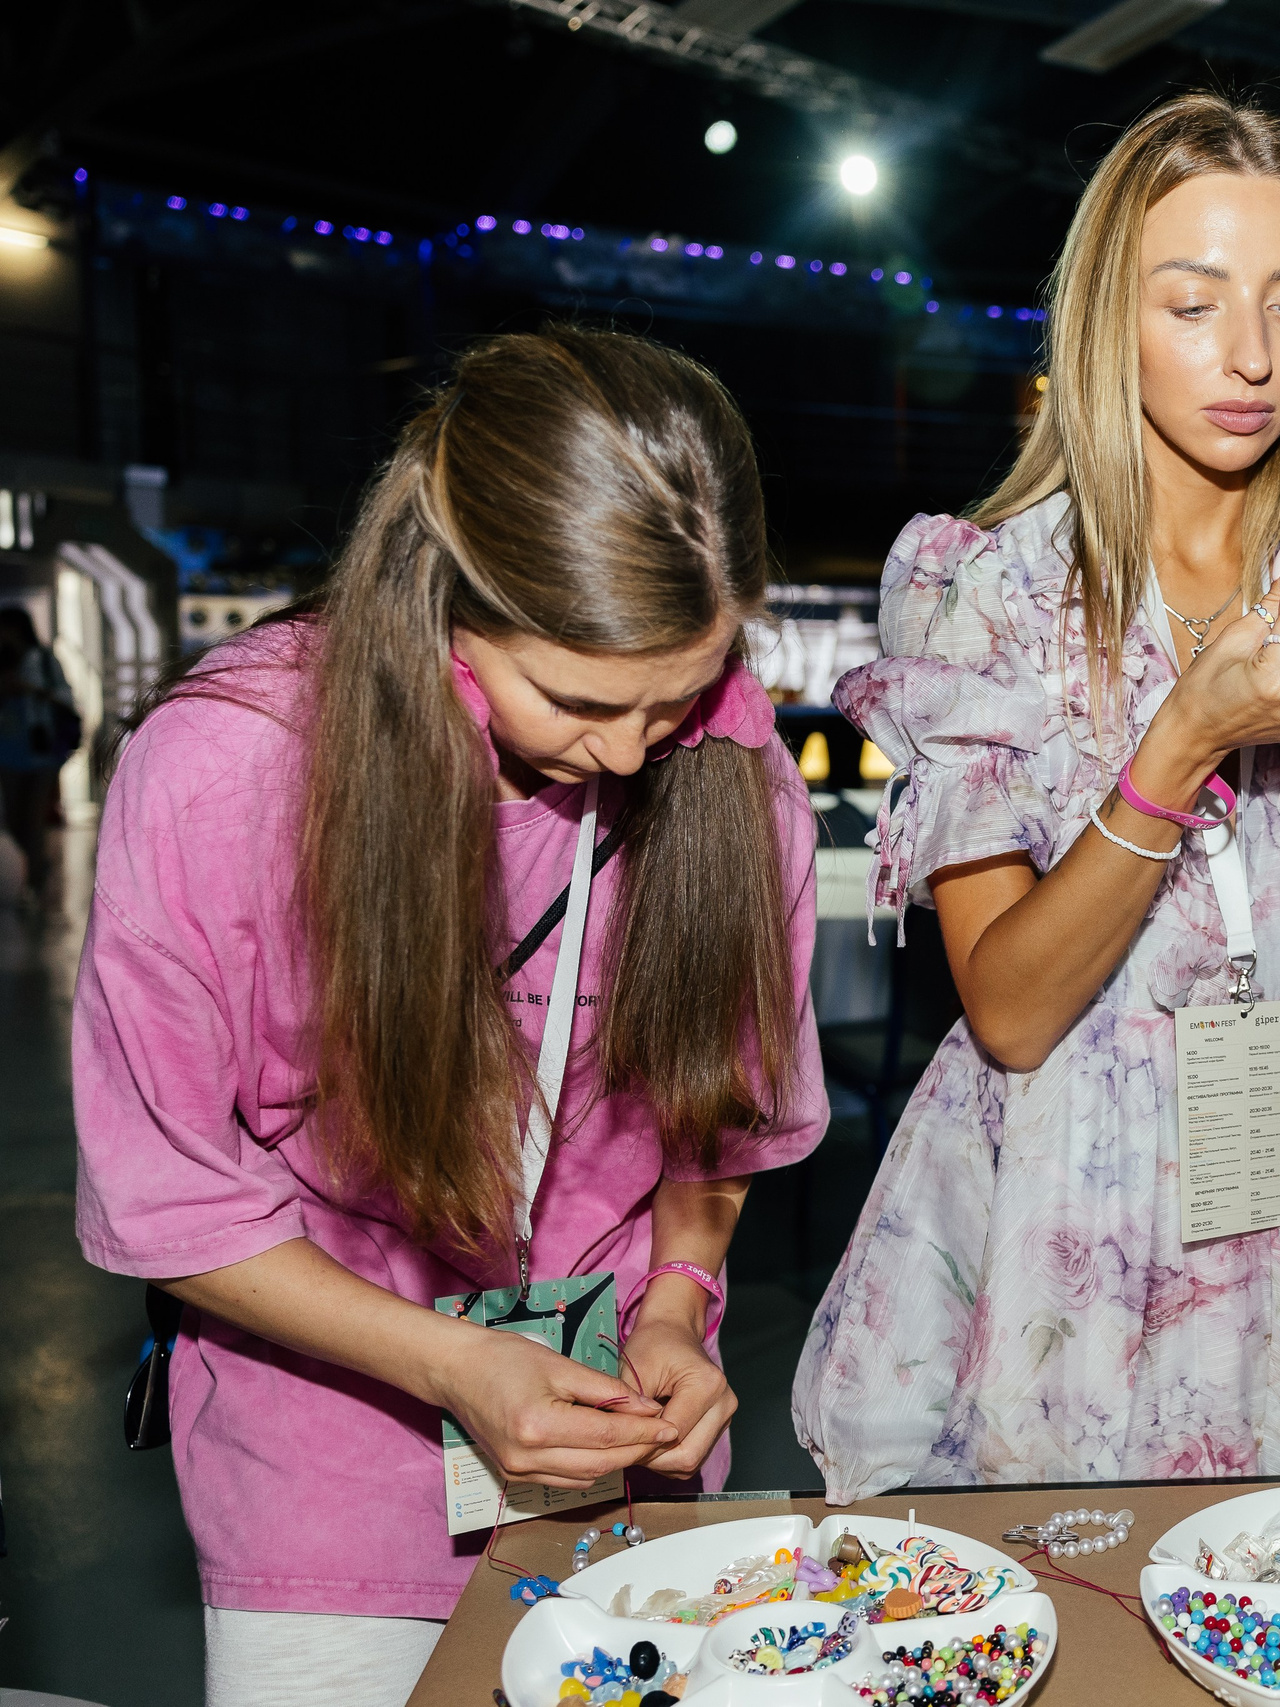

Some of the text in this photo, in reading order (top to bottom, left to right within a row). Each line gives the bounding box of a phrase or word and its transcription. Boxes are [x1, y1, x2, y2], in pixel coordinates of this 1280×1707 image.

[527, 992, 543, 1006] BE
[1221, 1019, 1236, 1027] FEST
[671, 1262, 712, 1283] giper.fm
